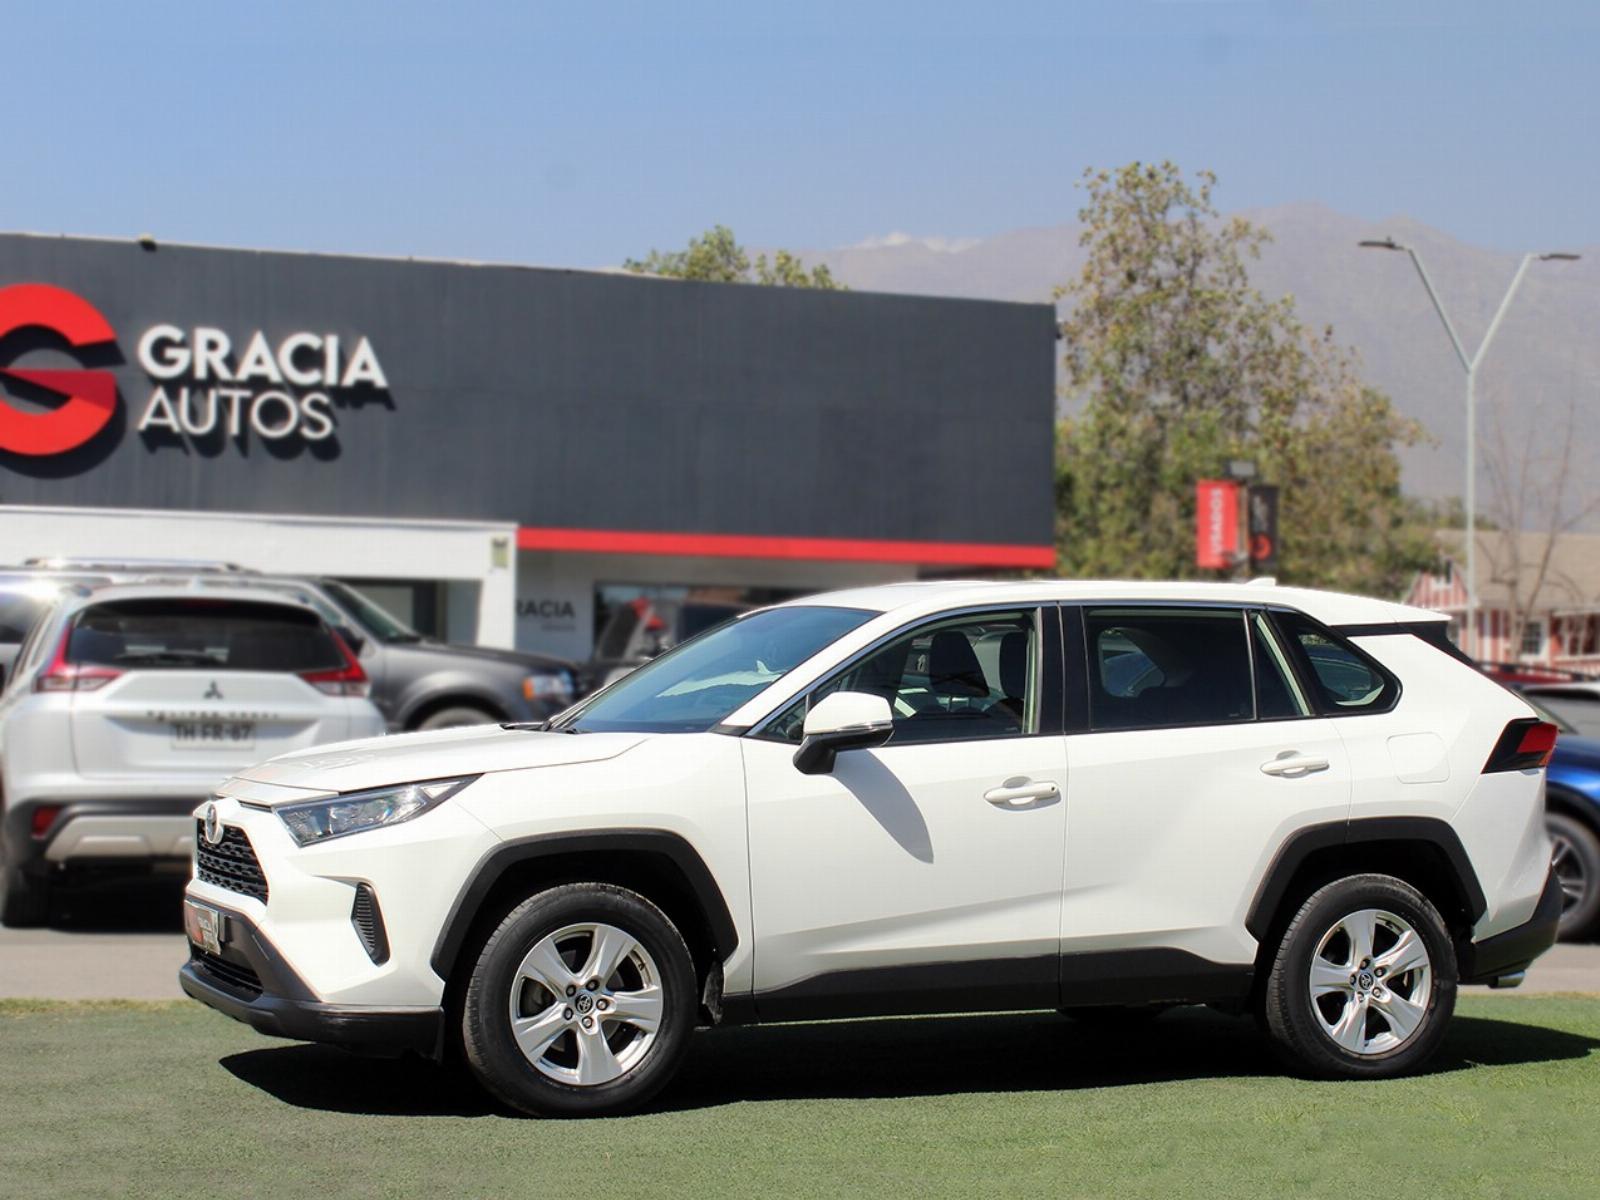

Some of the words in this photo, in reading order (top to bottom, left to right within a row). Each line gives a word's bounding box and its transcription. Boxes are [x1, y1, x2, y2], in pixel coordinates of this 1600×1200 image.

[137, 325, 389, 387] GRACIA
[138, 387, 334, 440] AUTOS
[515, 600, 576, 618] RACIA
